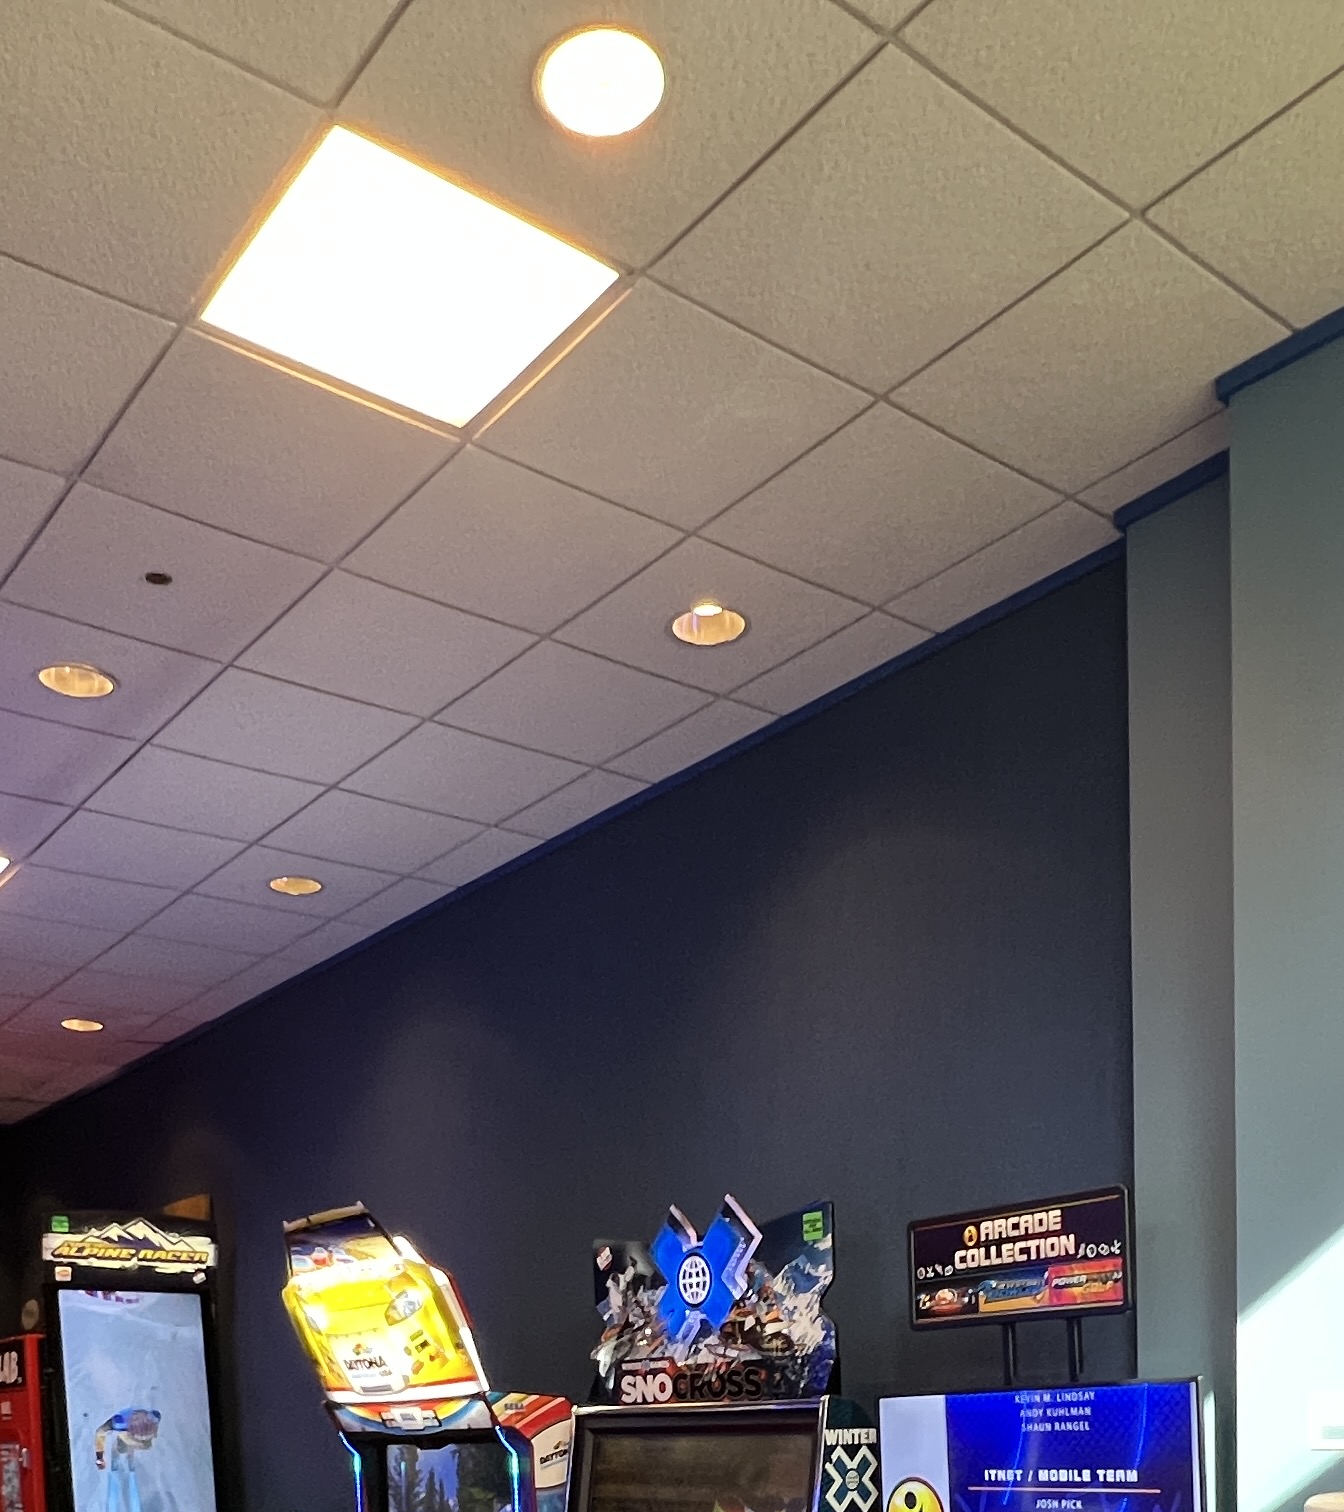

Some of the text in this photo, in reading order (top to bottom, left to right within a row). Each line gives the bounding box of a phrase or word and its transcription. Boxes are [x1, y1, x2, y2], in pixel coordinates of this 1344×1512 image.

[979, 1208, 1062, 1242] ARCADE
[53, 1245, 208, 1263] ALPINE RACER
[954, 1233, 1076, 1270] COLLECTION
[343, 1355, 388, 1370] DAYTONA
[620, 1366, 763, 1404] SNOCROSS
[1056, 1391, 1095, 1402] LINDSAY
[1019, 1406, 1091, 1418] ANDY KUHLMAN
[1054, 1420, 1090, 1432] RANGEL
[824, 1427, 877, 1446] WINTER
[1038, 1468, 1092, 1482] MOBILE
[1096, 1469, 1139, 1483] TEAM
[1036, 1499, 1082, 1510] JOSH PICK
